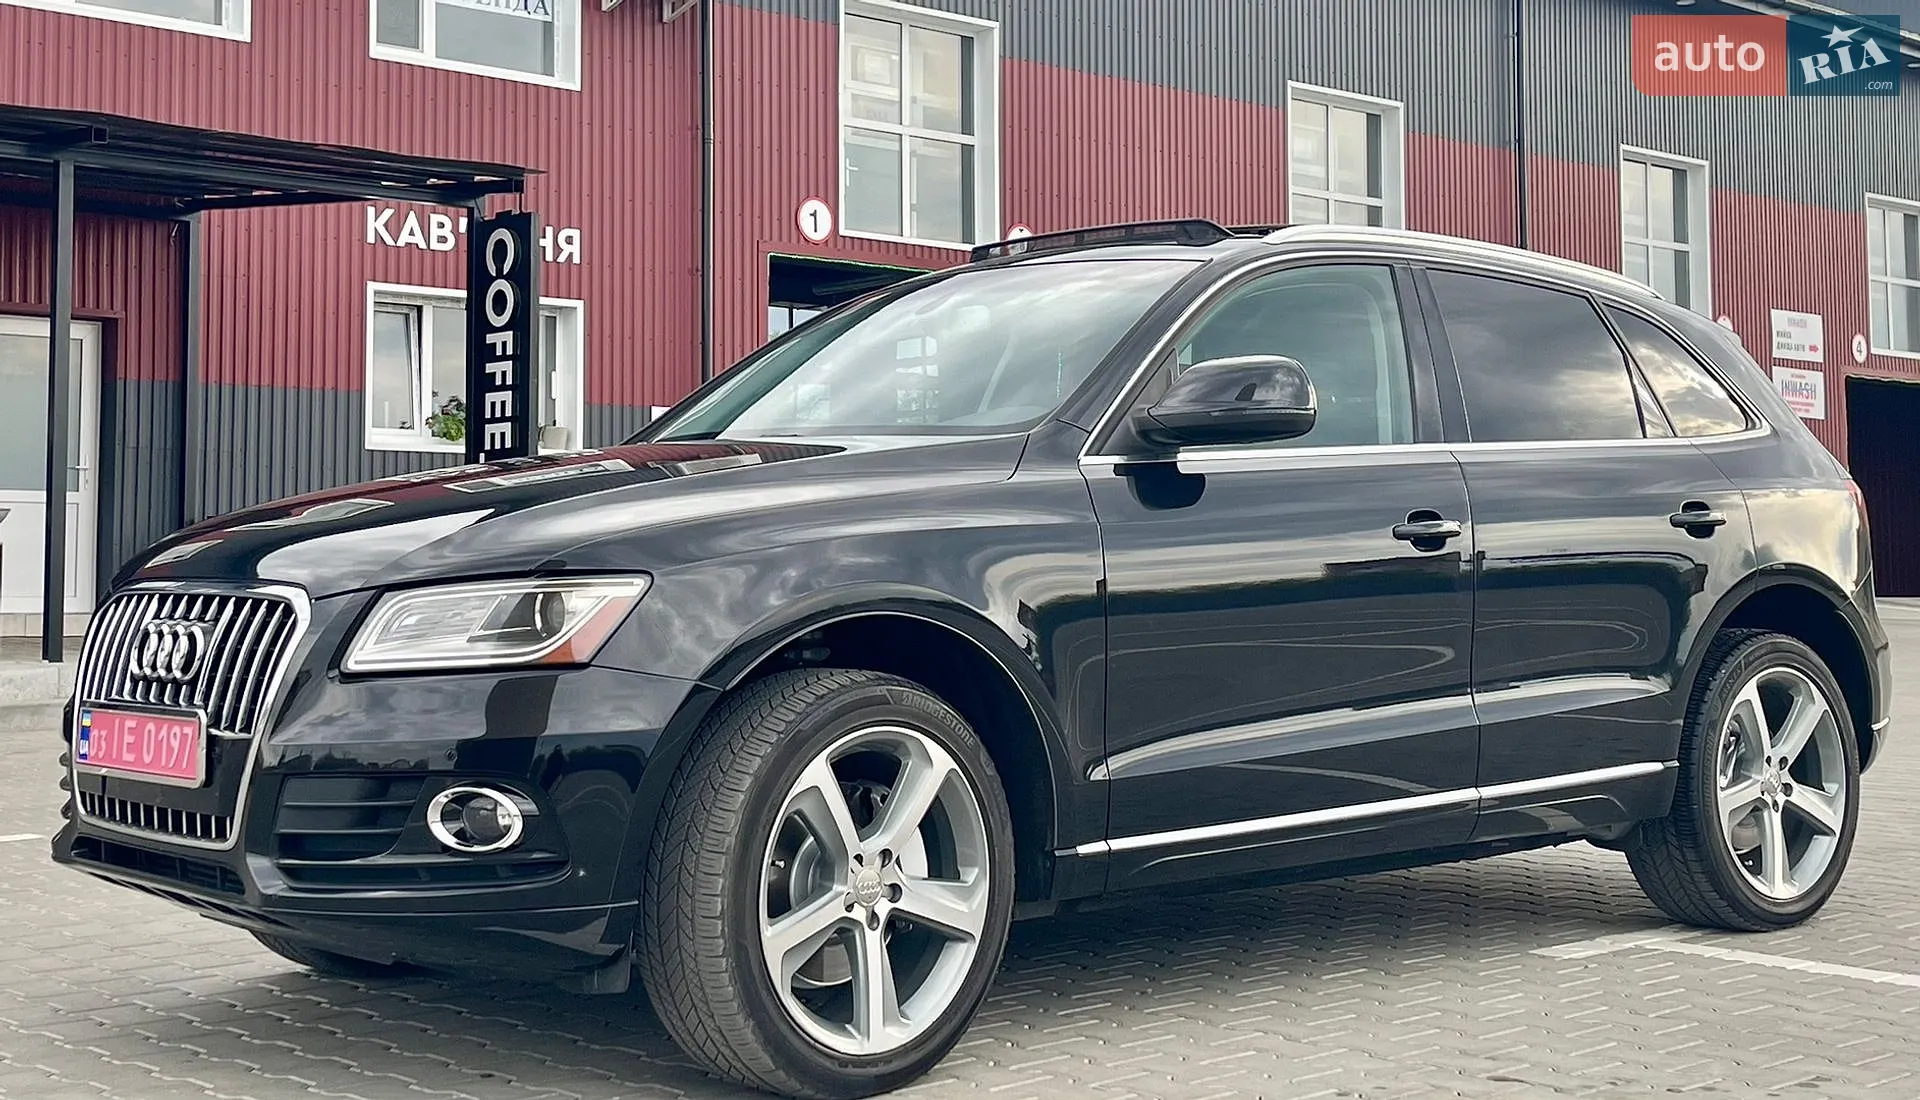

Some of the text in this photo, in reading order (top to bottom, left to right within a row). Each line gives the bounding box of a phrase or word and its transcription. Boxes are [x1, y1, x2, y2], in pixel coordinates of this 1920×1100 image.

[809, 209, 818, 233] 1
[484, 228, 515, 451] COFFEE
[1856, 341, 1862, 355] 4
[1781, 379, 1816, 400] INWASH
[905, 691, 976, 747] BRIDGESTONE
[89, 729, 108, 758] 03
[142, 721, 194, 769] 0197
